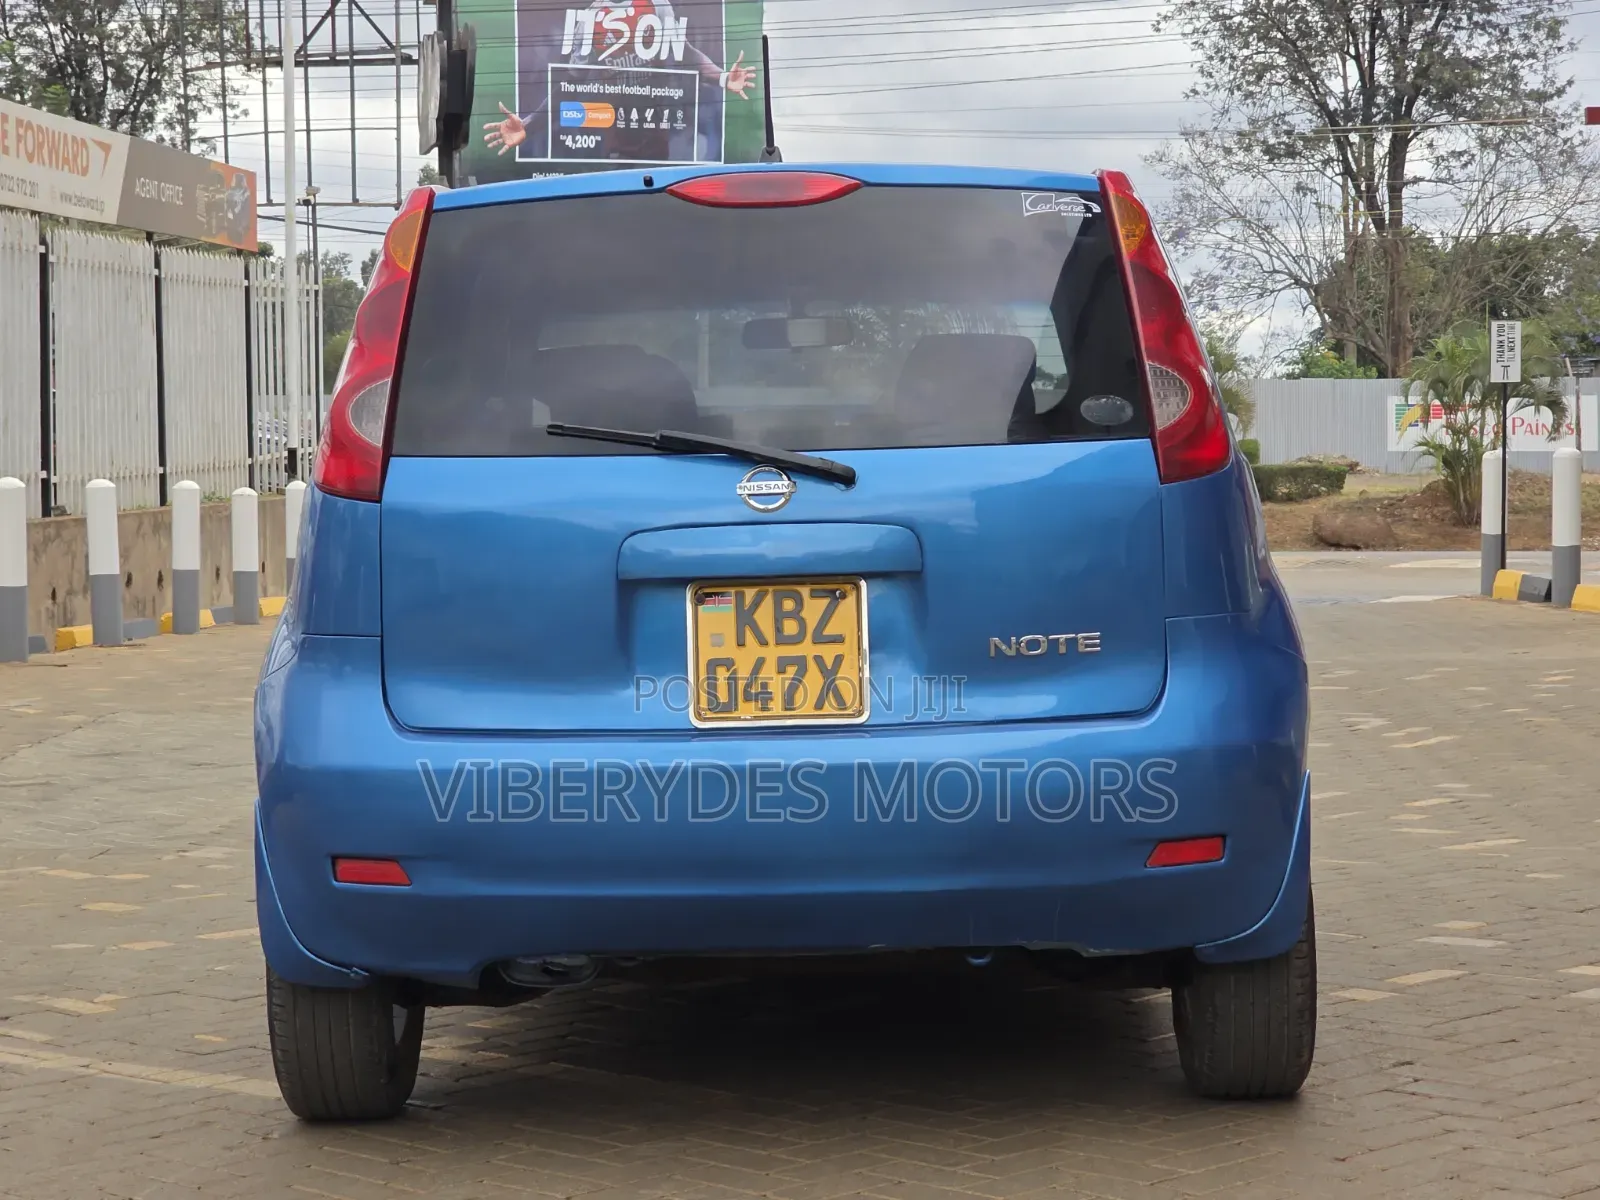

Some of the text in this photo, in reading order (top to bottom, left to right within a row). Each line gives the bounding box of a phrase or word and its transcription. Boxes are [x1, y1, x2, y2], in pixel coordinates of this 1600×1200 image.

[561, 6, 688, 61] IT'S ON
[560, 81, 684, 99] The world's best football package
[15, 116, 90, 178] FORWARD
[135, 177, 183, 206] AGENT OFFICE
[1496, 323, 1506, 363] THANK YOU
[1507, 336, 1516, 353] NEXT
[743, 483, 790, 492] NISSAN
[735, 588, 846, 648] KBZ
[989, 632, 1101, 657] NOTE
